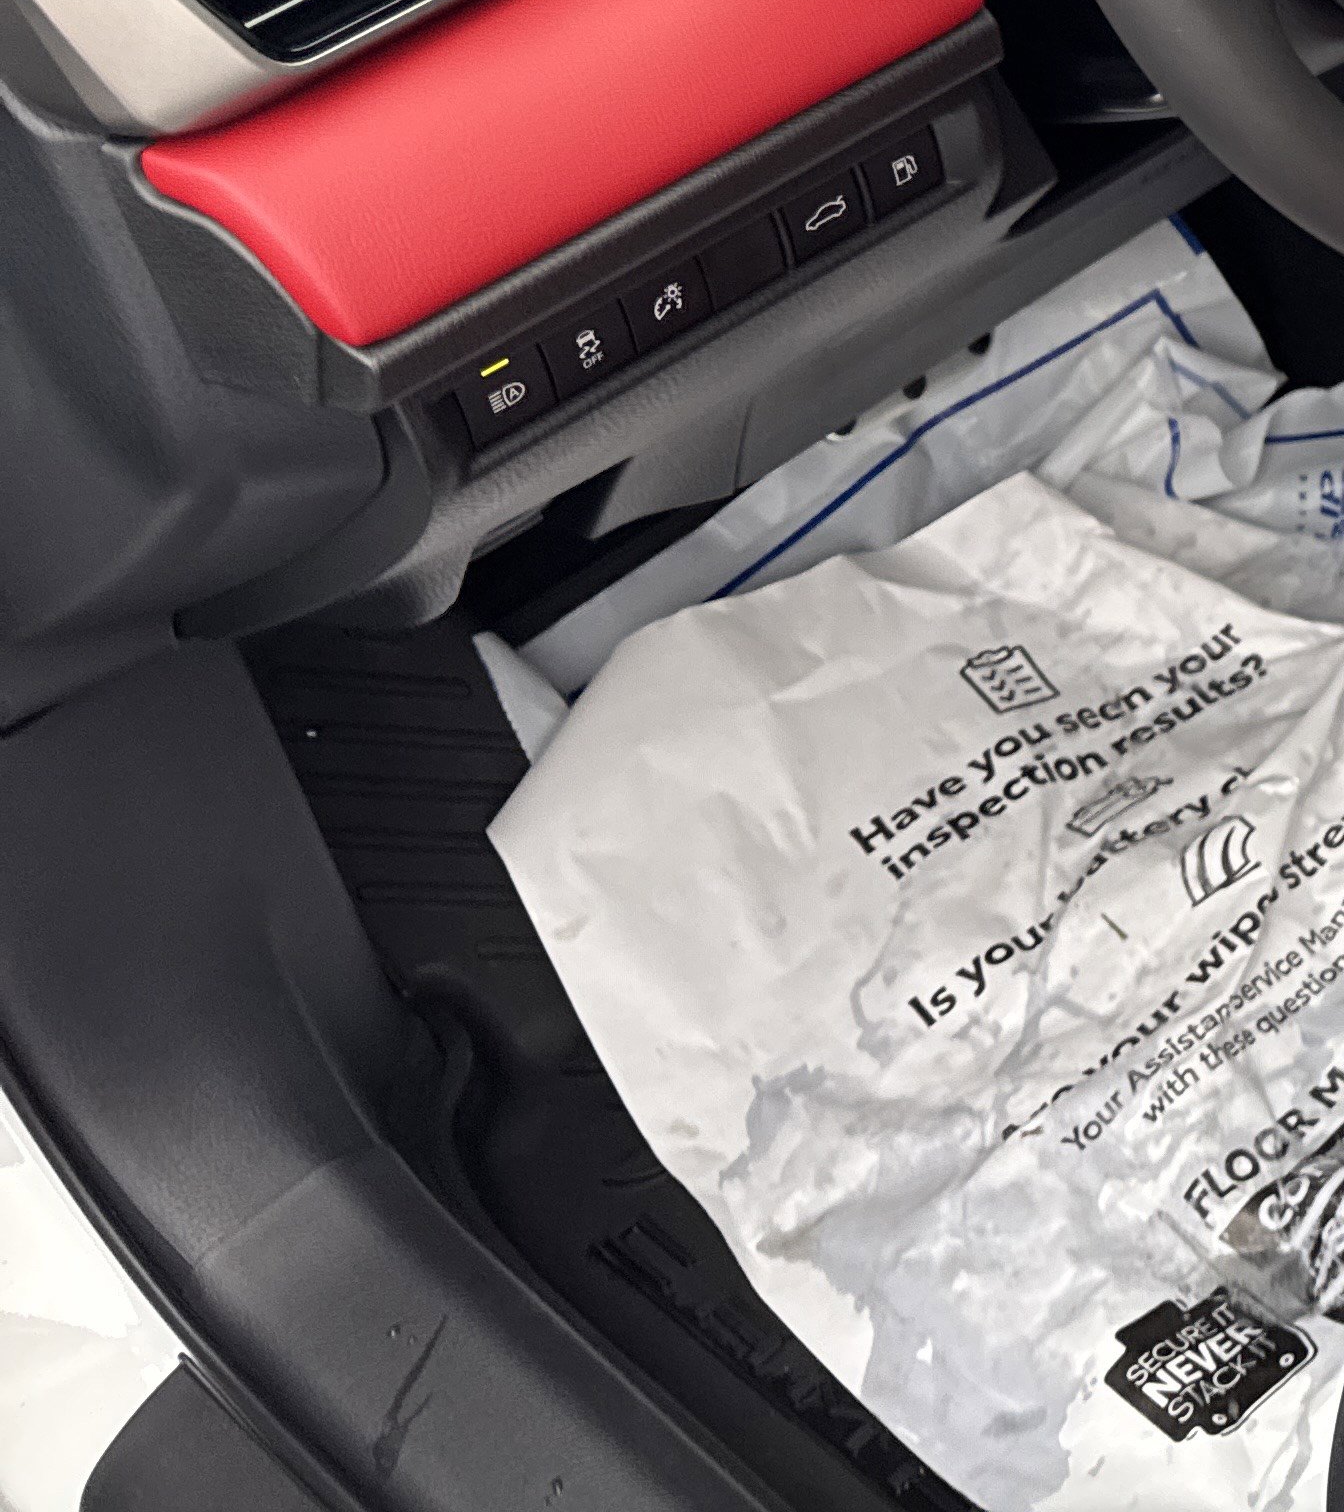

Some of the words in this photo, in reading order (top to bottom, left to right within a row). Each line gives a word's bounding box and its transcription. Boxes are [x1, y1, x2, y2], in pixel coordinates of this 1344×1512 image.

[582, 350, 605, 369] OFF
[850, 774, 967, 855] Have
[969, 722, 1051, 783] you
[1154, 623, 1243, 694] your
[881, 750, 1107, 880] inspection
[1112, 653, 1270, 755] results?
[908, 984, 958, 1028] Is
[956, 913, 1054, 995] your
[1062, 1092, 1126, 1153] Your
[1128, 1003, 1231, 1090] Assistan
[1141, 1059, 1201, 1124] with
[1200, 1029, 1256, 1071] these
[1126, 1316, 1219, 1388] SECURE
[1211, 1302, 1236, 1327] IT
[1141, 1320, 1264, 1409] NEVER
[1167, 1354, 1256, 1424] STACK
